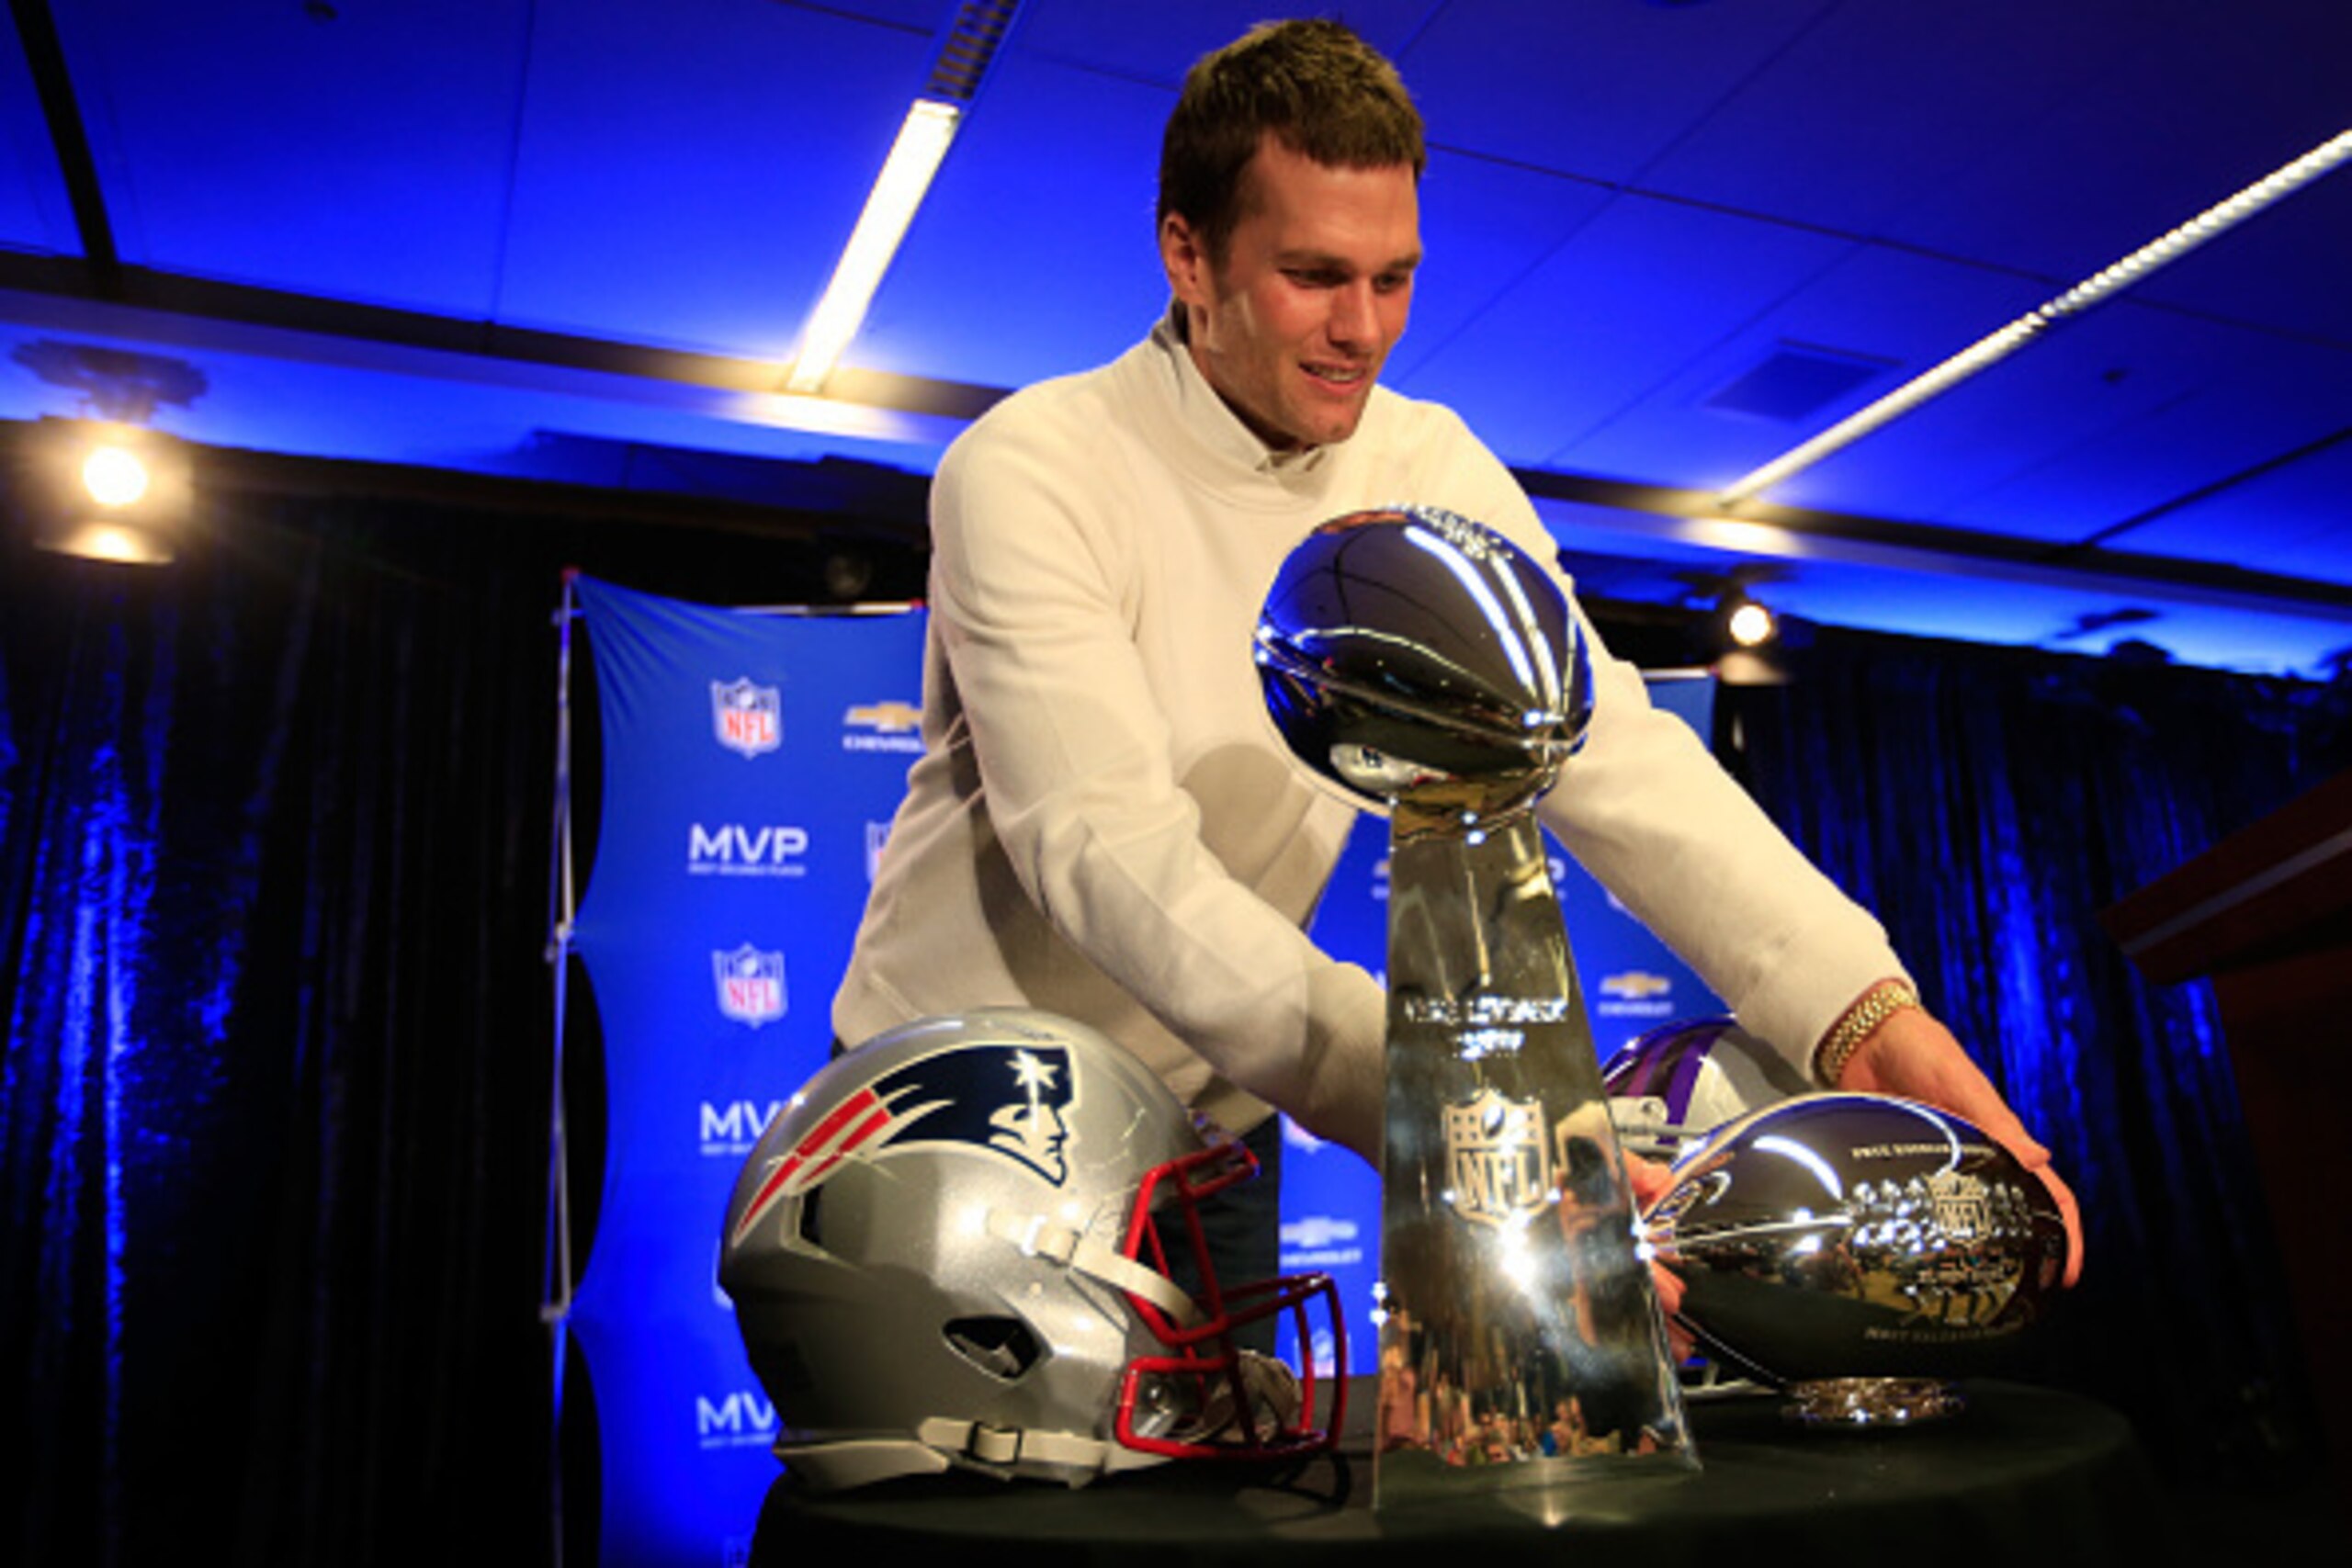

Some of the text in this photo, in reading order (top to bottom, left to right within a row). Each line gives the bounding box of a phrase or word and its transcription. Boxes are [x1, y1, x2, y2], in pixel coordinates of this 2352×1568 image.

[724, 709, 776, 743] NFL
[842, 736, 926, 753] CHEVROL
[690, 823, 808, 863] MVP
[727, 979, 780, 1014] NFL
[701, 1100, 781, 1140] MV
[1453, 1149, 1543, 1213] NFL
[1937, 1202, 1987, 1237] NFL
[1279, 1249, 1363, 1268] HEVROLET
[697, 1392, 775, 1435] MV
